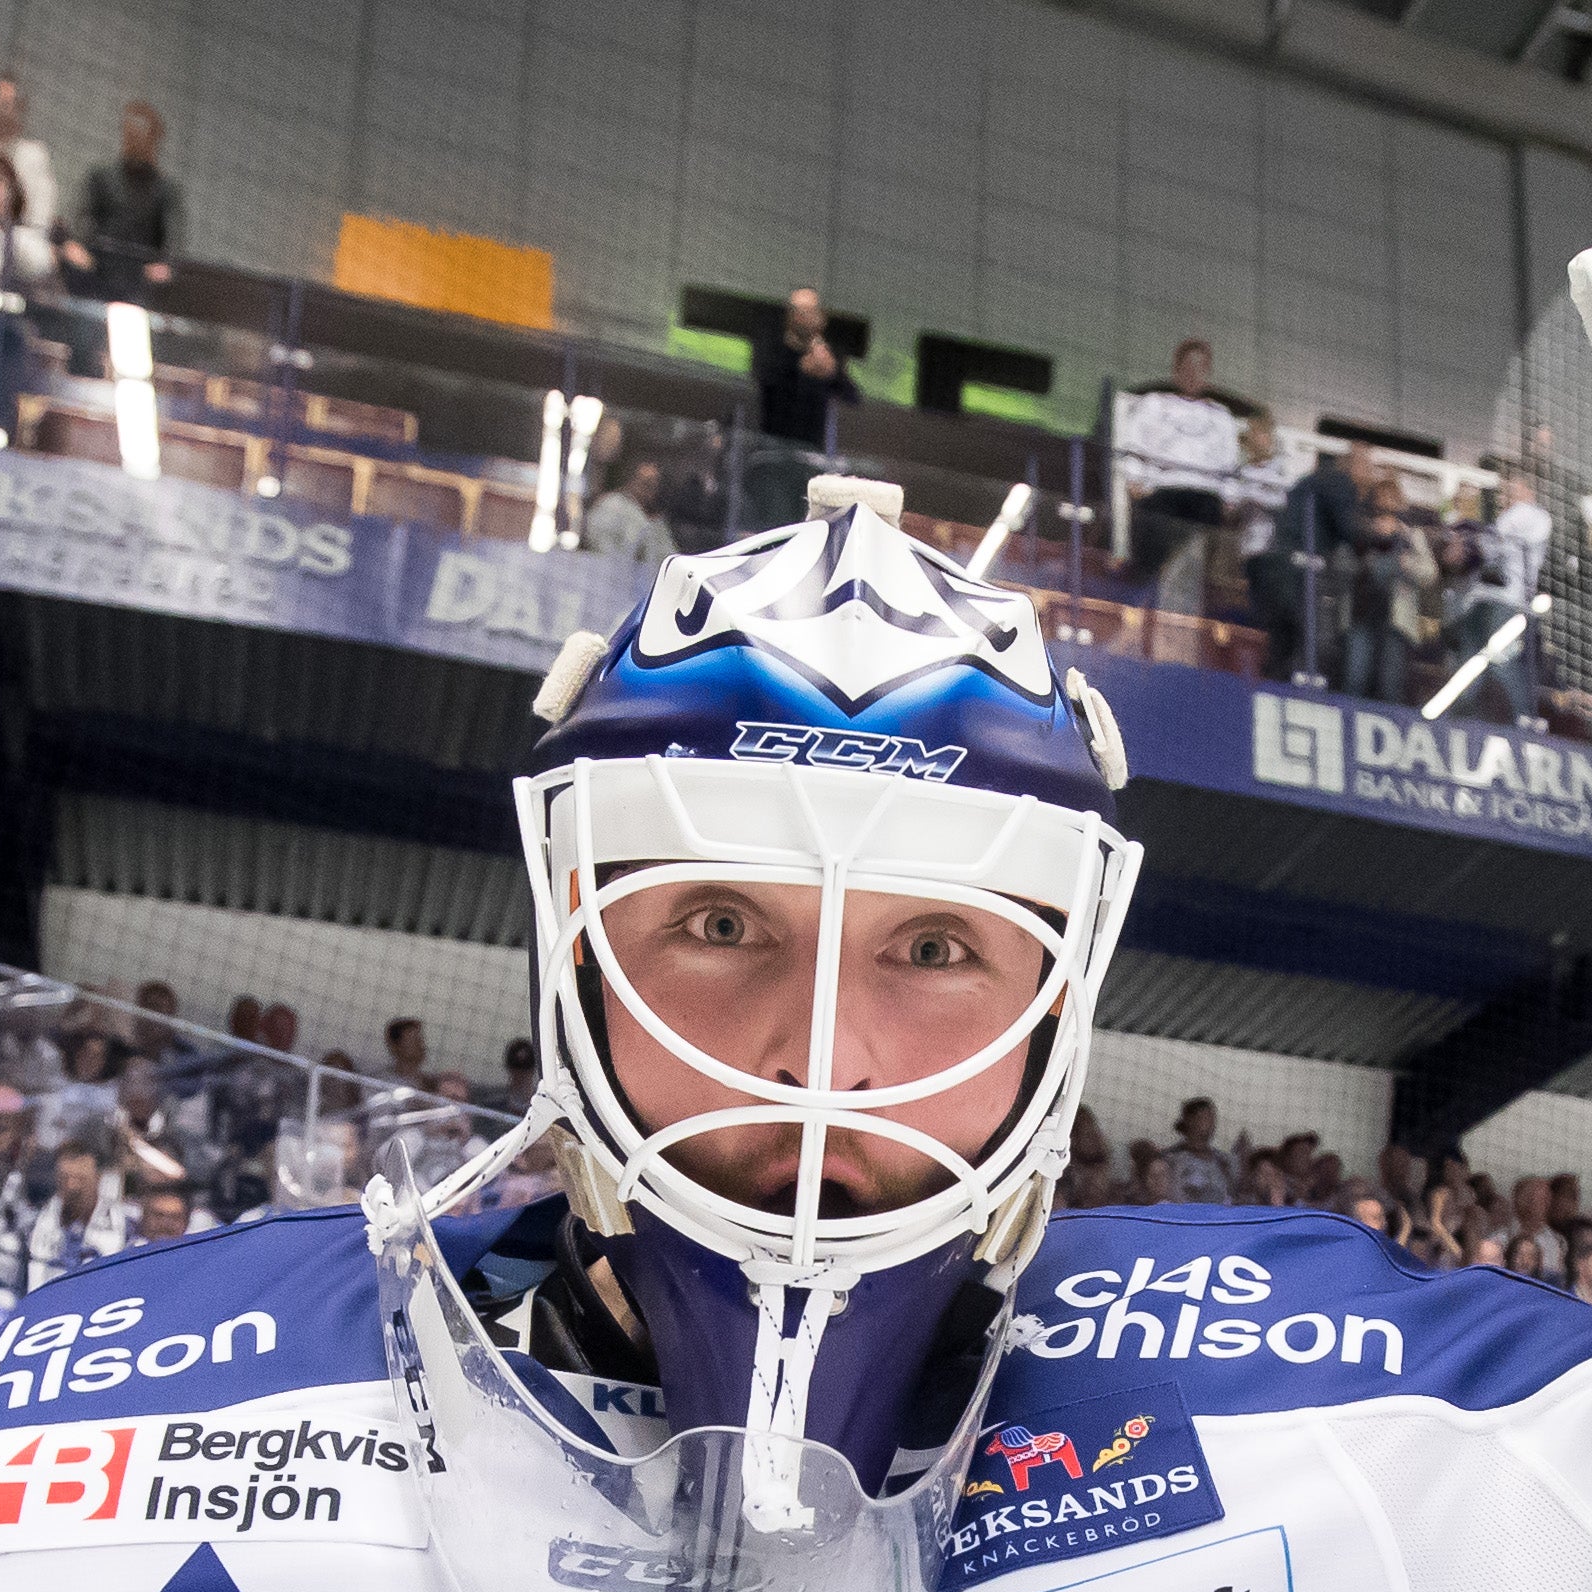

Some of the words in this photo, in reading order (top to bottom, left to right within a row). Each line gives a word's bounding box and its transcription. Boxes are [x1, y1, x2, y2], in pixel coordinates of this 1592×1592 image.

[728, 720, 969, 783] CCM
[157, 1419, 411, 1473] Bergkvis
[145, 1475, 342, 1533] Insjön
[945, 1464, 1200, 1558] EKSANDS
[963, 1511, 1162, 1575] KNÄCKEBRÖD
